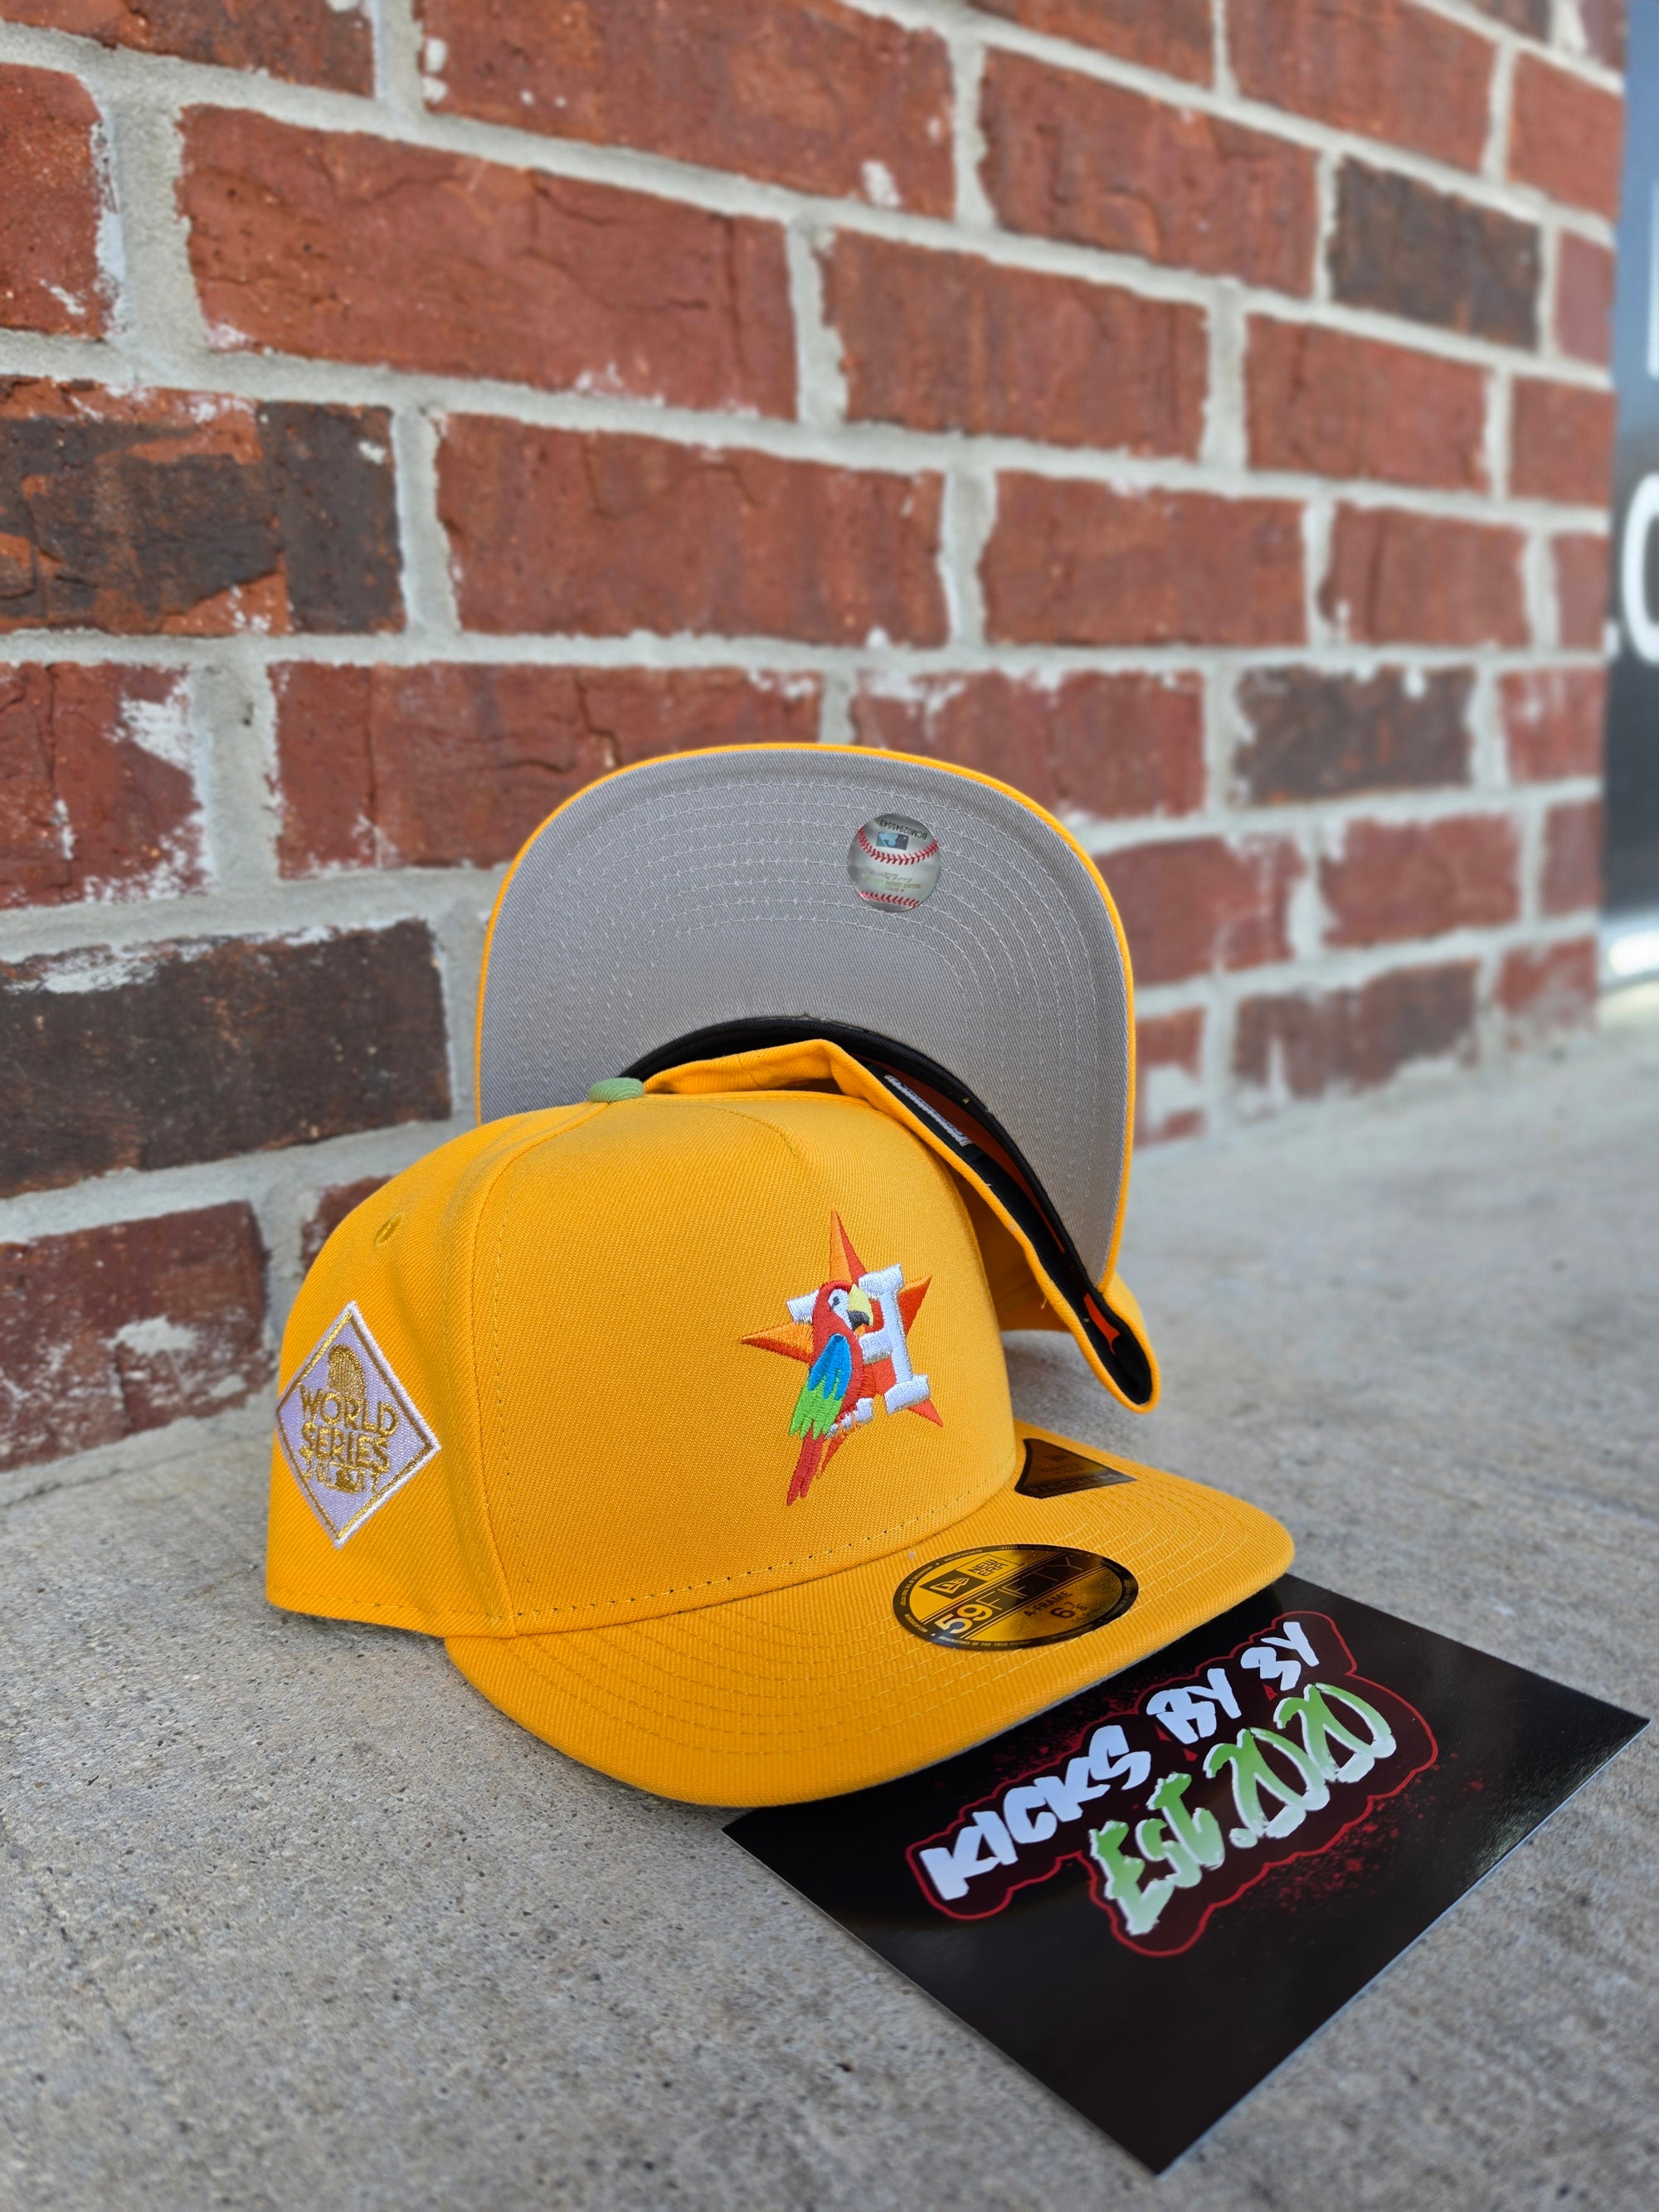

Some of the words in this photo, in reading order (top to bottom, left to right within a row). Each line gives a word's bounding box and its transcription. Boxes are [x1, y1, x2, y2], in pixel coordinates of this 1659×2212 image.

[299, 1383, 399, 1436] WORLD
[299, 1420, 391, 1473] SERIES
[966, 1558, 998, 1574] NEW
[978, 1563, 1010, 1577] ERA
[936, 1554, 1083, 1635] 59FIFTY
[1023, 1591, 1073, 1617] A-FRAME
[919, 1725, 1151, 1901] KICKS
[1146, 1668, 1242, 1745] BY
